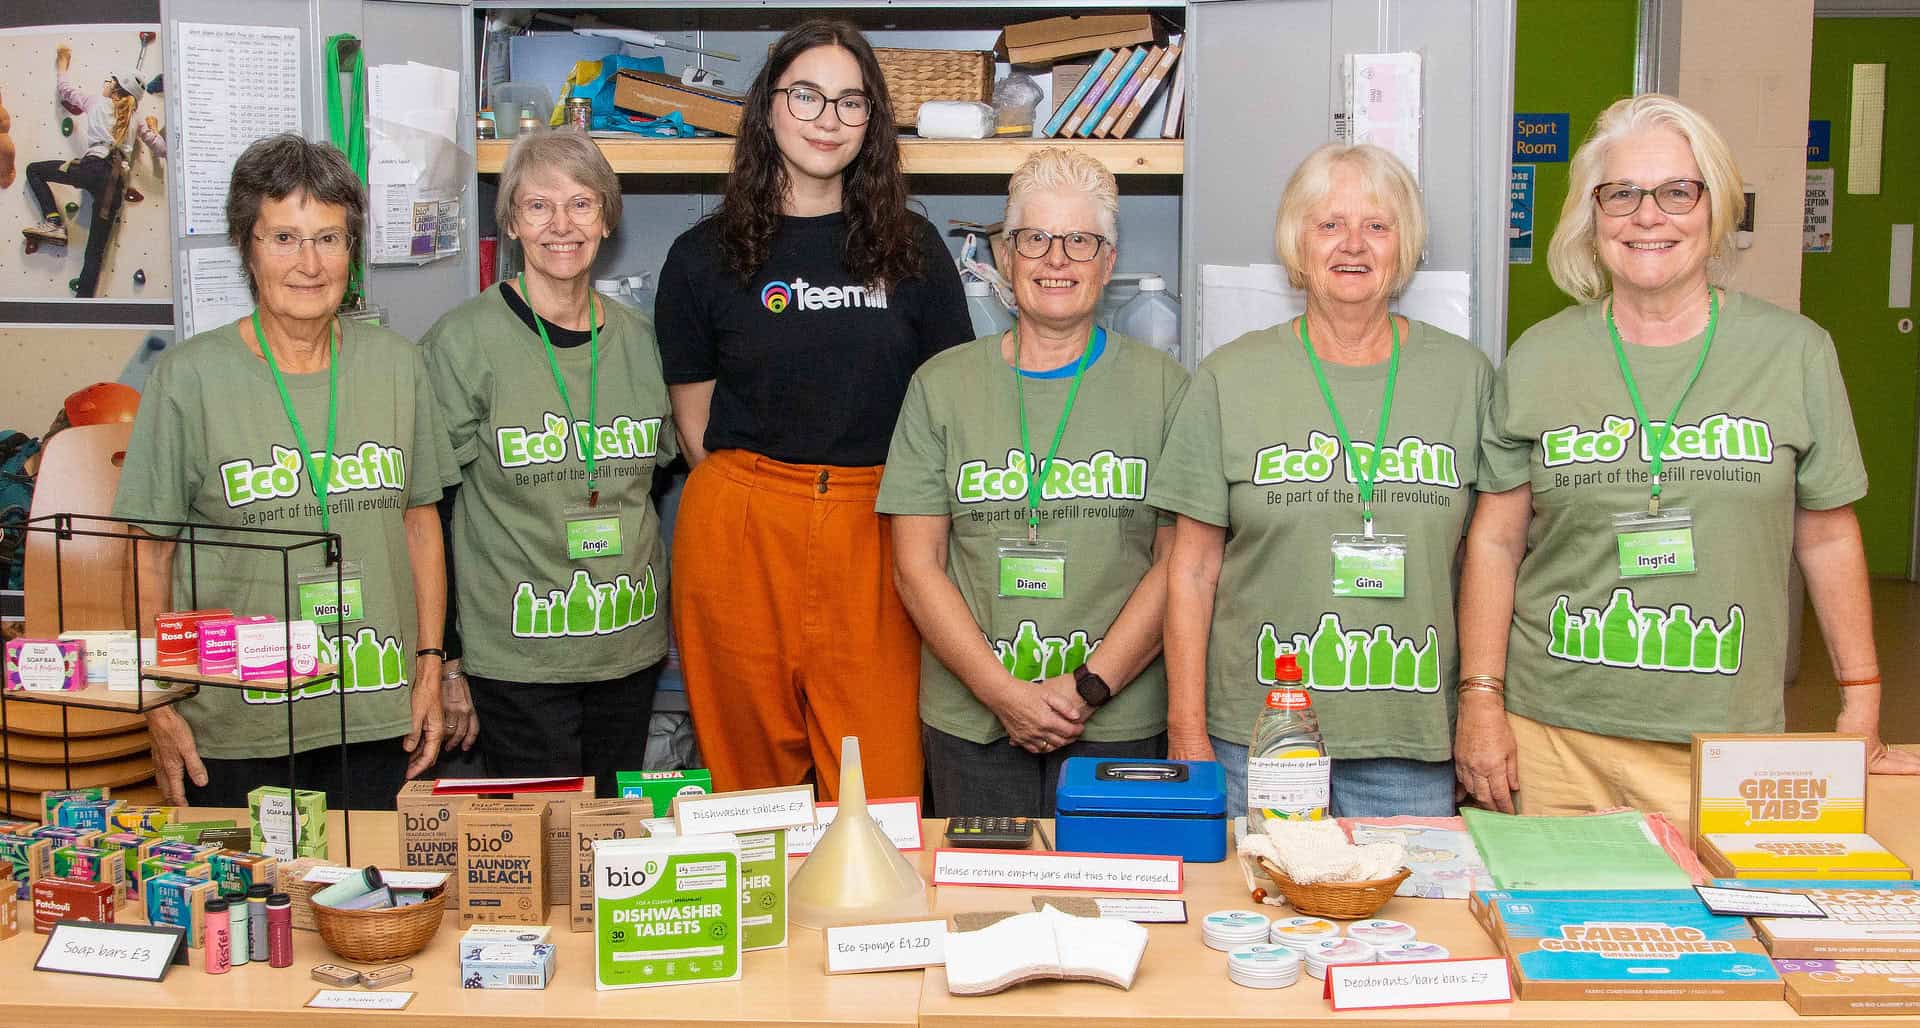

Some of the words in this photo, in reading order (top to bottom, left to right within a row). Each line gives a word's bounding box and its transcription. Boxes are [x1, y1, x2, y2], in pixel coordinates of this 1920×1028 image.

[1517, 120, 1558, 137] Sport
[1516, 141, 1557, 154] Room
[790, 277, 888, 311] teemill
[497, 426, 566, 467] Eco
[1541, 425, 1627, 468] Eco
[1639, 413, 1774, 464] Refill
[1252, 443, 1334, 486] Eco
[220, 459, 300, 508] Eco
[515, 473, 530, 487] Be
[533, 470, 554, 487] part
[557, 468, 568, 481] of
[569, 467, 585, 481] the
[957, 460, 1029, 503] Eco
[1040, 450, 1148, 501] Refill
[1555, 472, 1570, 488] Be
[1574, 469, 1602, 489] part
[1607, 467, 1620, 484] of
[1626, 467, 1649, 484] the
[1652, 466, 1685, 483] efill
[1690, 465, 1762, 484] revolution
[1266, 491, 1282, 505] Be
[1286, 489, 1313, 507] part
[1316, 488, 1330, 503] of
[1333, 488, 1354, 503] the
[1358, 488, 1387, 503] rfill
[1391, 489, 1451, 508] revolution
[259, 506, 286, 525] part
[288, 502, 302, 519] of
[304, 502, 323, 518] the
[326, 498, 354, 518] refill
[971, 509, 985, 523] Be
[986, 508, 1011, 524] part
[1014, 507, 1026, 520] of
[1052, 504, 1080, 519] refill
[1082, 504, 1135, 520] revolution
[582, 539, 609, 552] Angie
[1638, 552, 1676, 568] Ingrid
[1016, 578, 1048, 590] Diane
[1355, 576, 1384, 589] Gina
[314, 603, 351, 617] Weny
[161, 632, 183, 641] Rose
[243, 644, 293, 654] Condition
[296, 642, 312, 650] Bar
[131, 658, 151, 666] Vra
[1738, 778, 1828, 799] GREEN
[692, 806, 751, 820] Dishwasher
[752, 802, 786, 815] tablets
[1746, 799, 1820, 820] TABS
[1754, 841, 1847, 850] GREEN
[407, 853, 458, 866] BLEAC
[467, 859, 531, 870] LAUNDRY
[468, 871, 532, 884] BLEACH
[938, 865, 970, 877] Please
[972, 866, 1005, 878] return
[1007, 869, 1039, 881] empty
[1040, 868, 1061, 881] jars
[1063, 869, 1082, 881] and
[1106, 871, 1118, 882] to
[1120, 870, 1133, 882] be
[159, 886, 180, 897] FAITH
[35, 898, 71, 912] Patchouli
[612, 903, 722, 923] DISHWASHER
[612, 930, 625, 939] 30
[634, 919, 701, 937] TABLETS
[1561, 925, 1704, 942] FABRIC
[63, 940, 95, 957] Soap
[98, 940, 129, 959] bars
[130, 946, 151, 962] £3
[837, 942, 856, 954] Eco
[858, 940, 896, 958] sponge
[1541, 939, 1735, 954] CONDITIONER
[1442, 972, 1468, 986] bars
